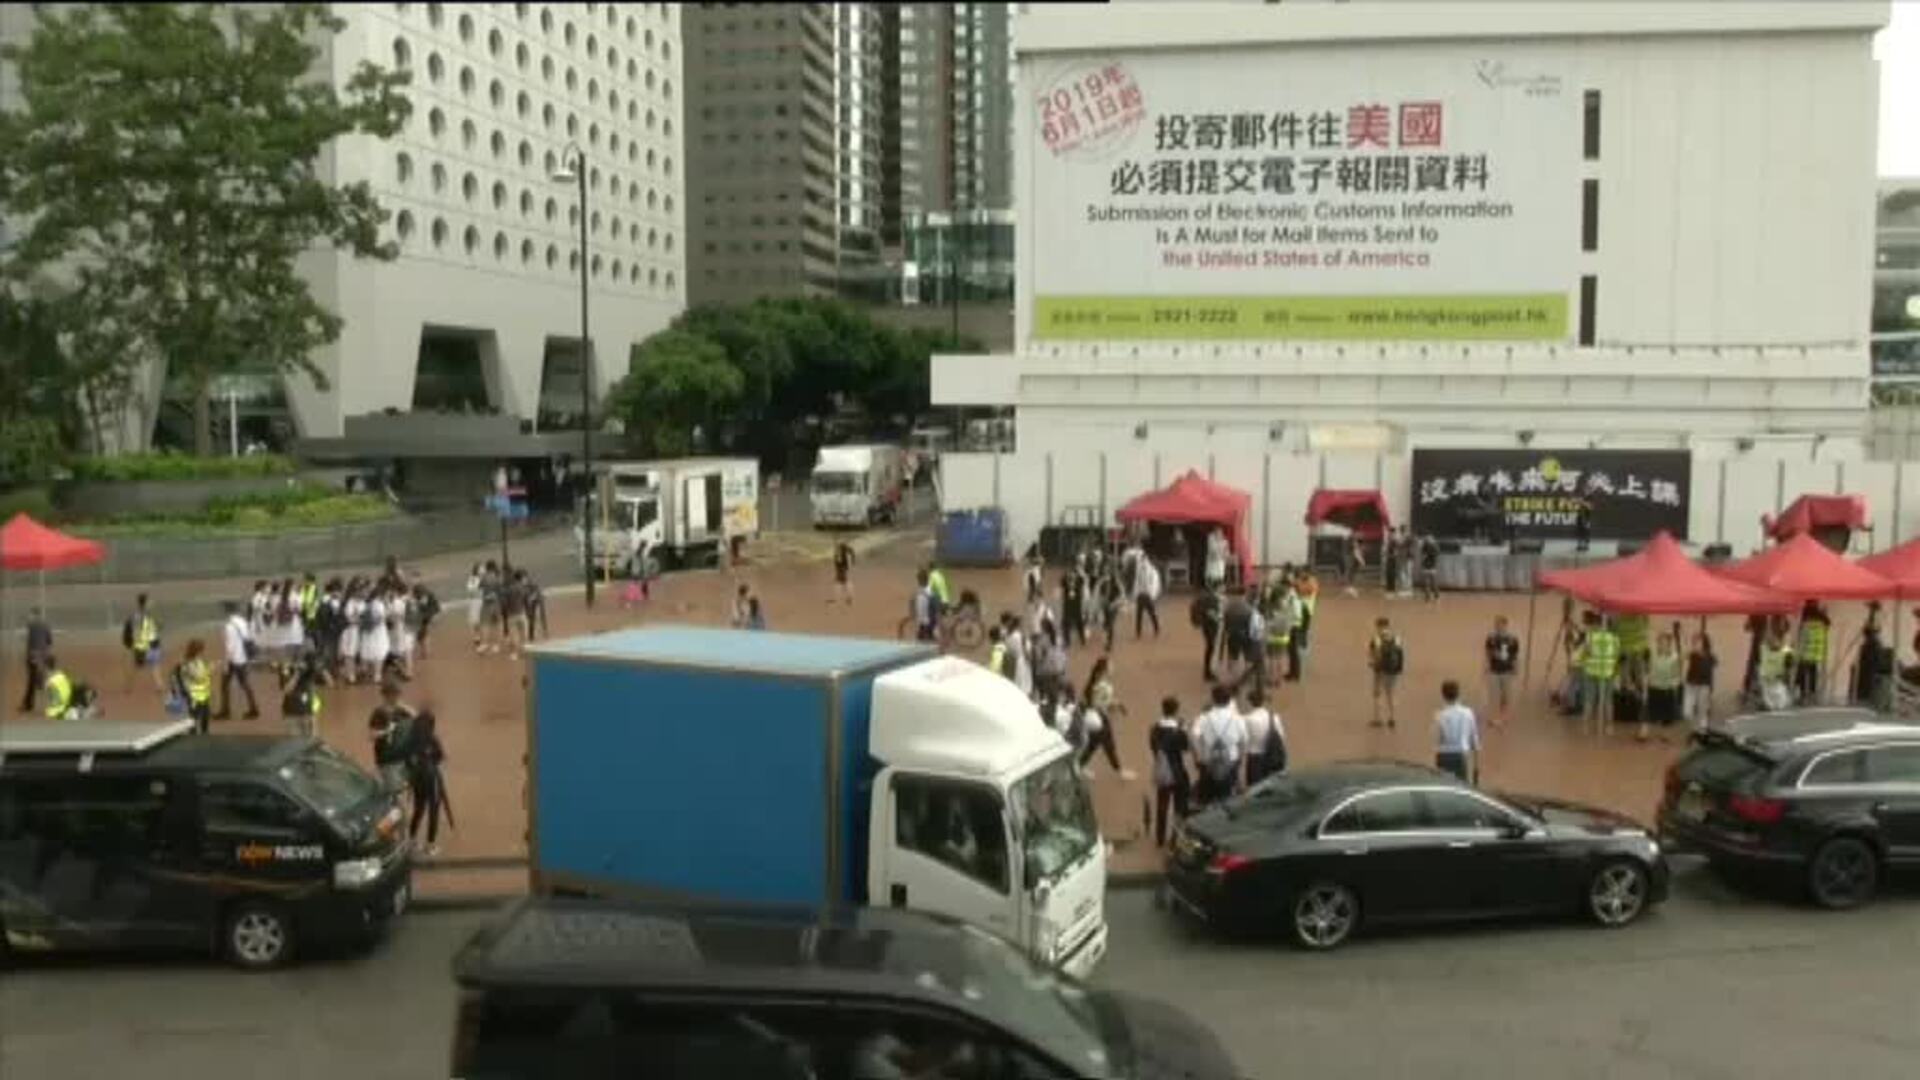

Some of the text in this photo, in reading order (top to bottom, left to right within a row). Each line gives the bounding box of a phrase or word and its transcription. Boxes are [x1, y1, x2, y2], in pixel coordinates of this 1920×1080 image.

[1037, 65, 1125, 119] 2019年
[1155, 102, 1442, 150] 投寄郵件往美國
[1111, 154, 1489, 195] 必須提交電子報關資料
[1086, 201, 1514, 221] Submission of Electronic Customs Information
[1156, 225, 1439, 243] Is A Must for Mail Items Sent to
[1163, 249, 1431, 267] the United States of America
[1503, 496, 1555, 511] STRIKE
[1504, 511, 1531, 526] THE
